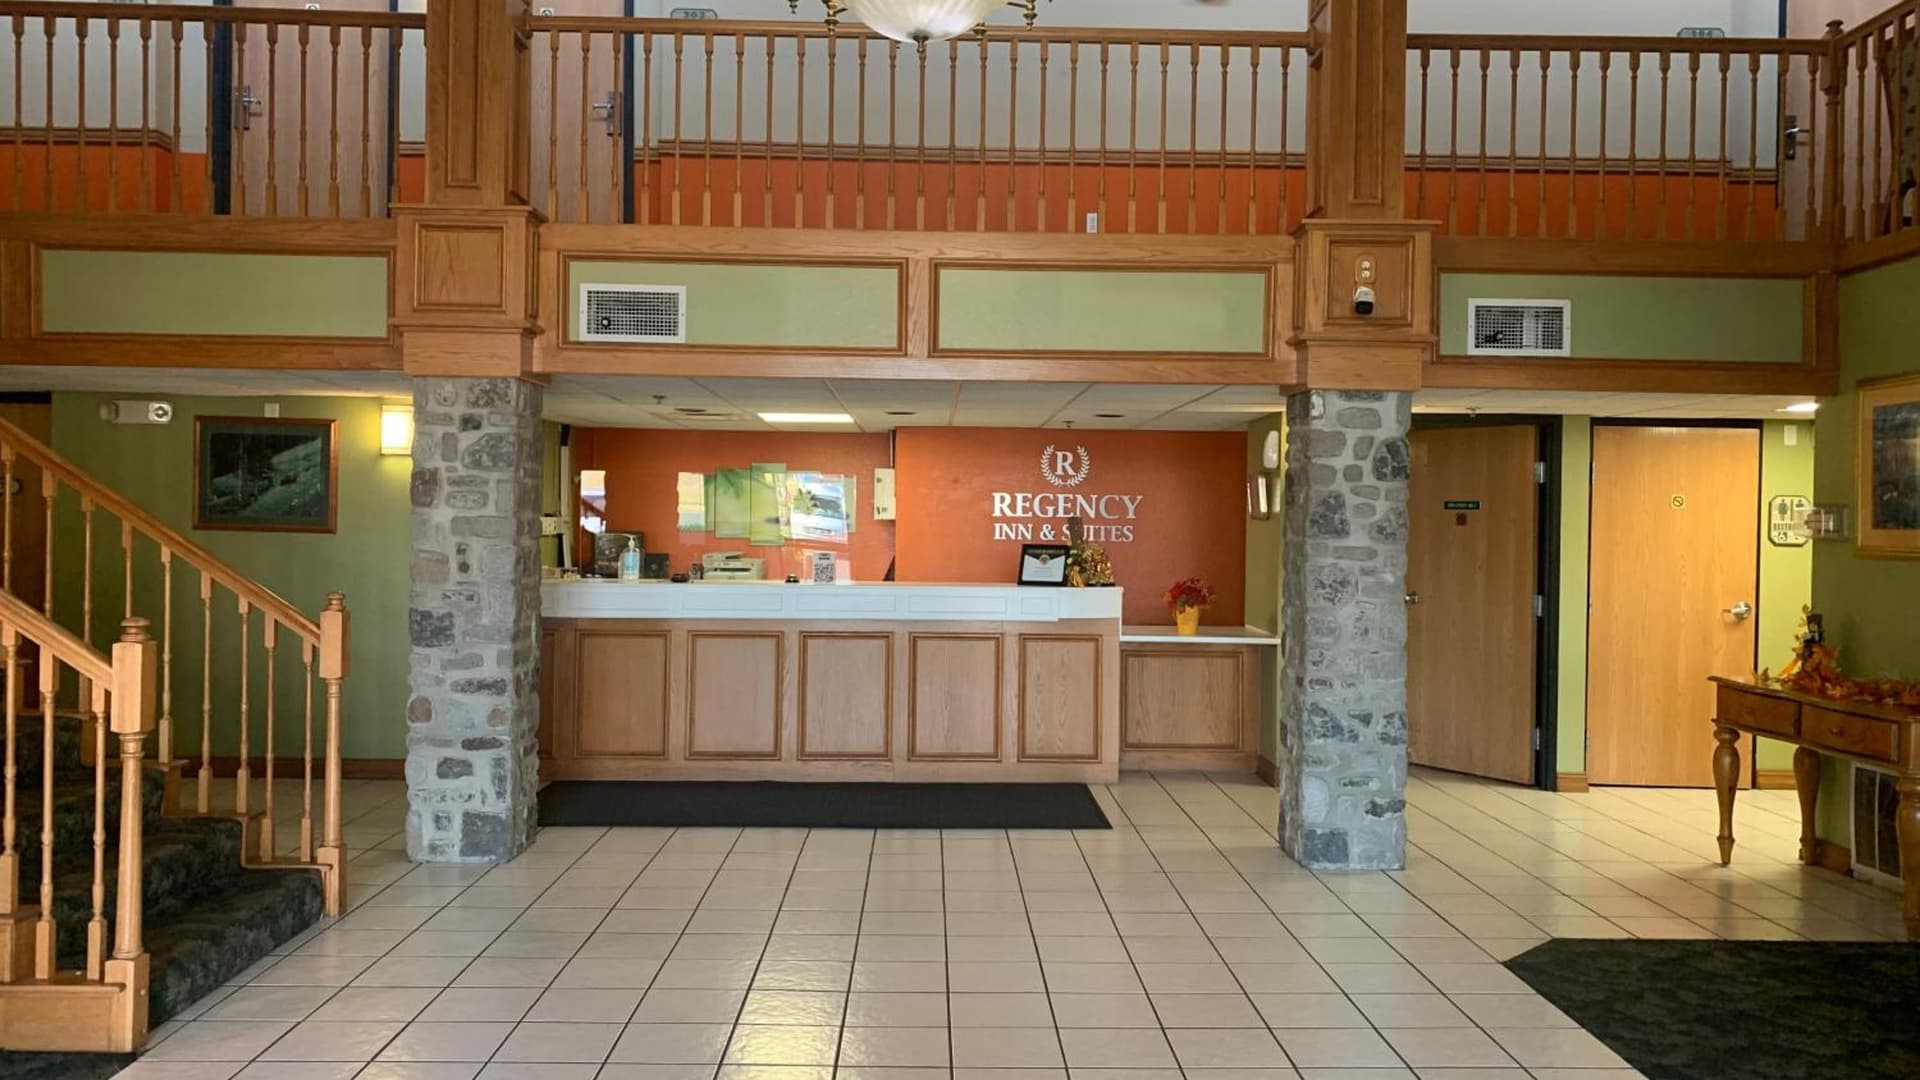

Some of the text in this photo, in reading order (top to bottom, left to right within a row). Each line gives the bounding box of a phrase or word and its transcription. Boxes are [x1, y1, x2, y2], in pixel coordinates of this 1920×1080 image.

[1055, 451, 1076, 475] R
[992, 492, 1143, 519] REGENCY
[993, 523, 1032, 540] INN
[1040, 523, 1056, 541] &
